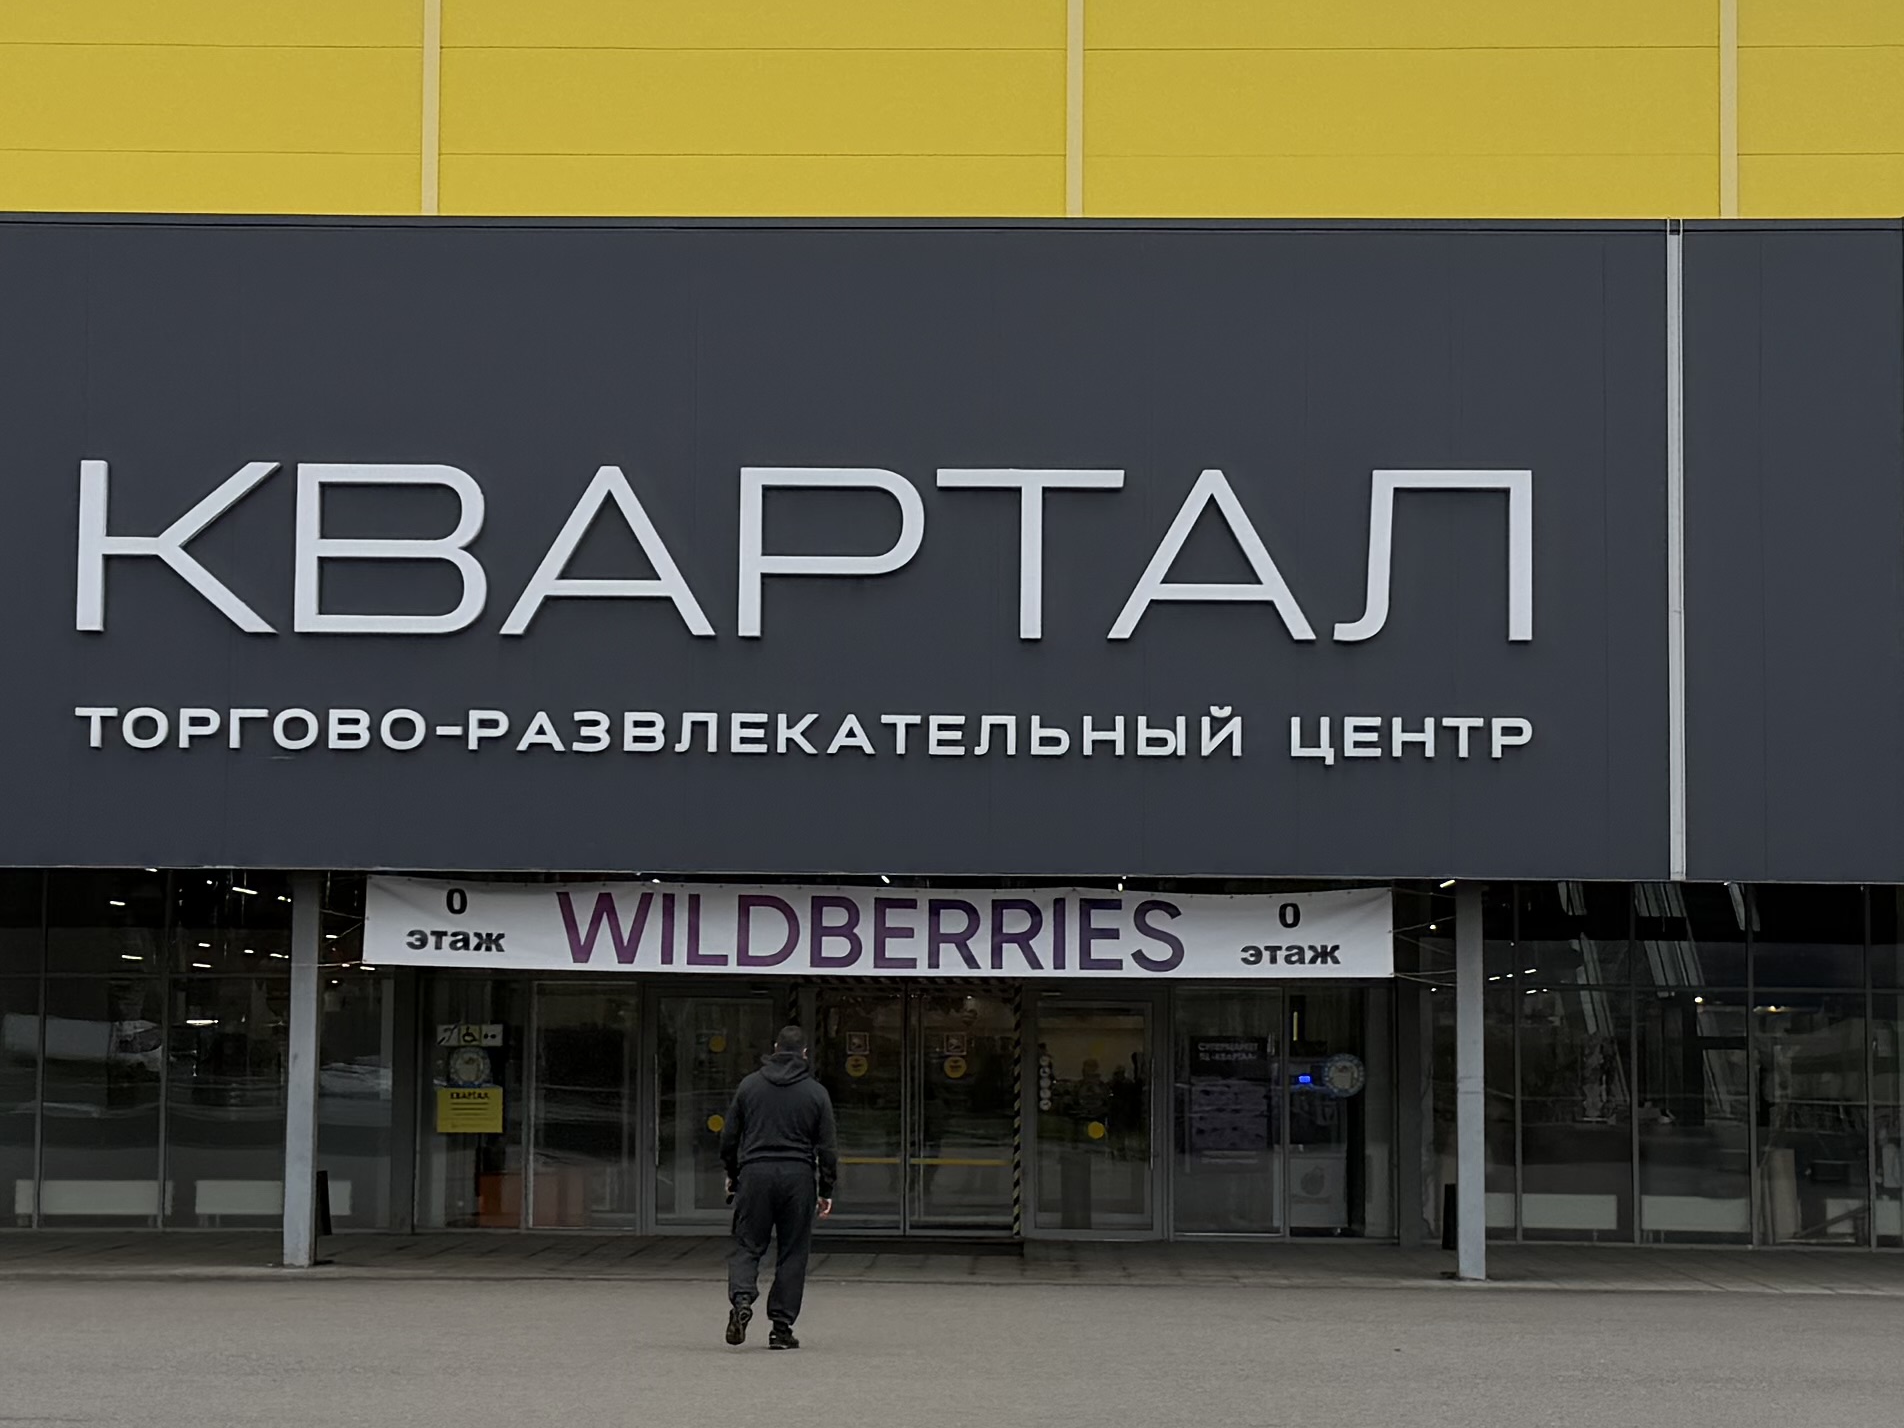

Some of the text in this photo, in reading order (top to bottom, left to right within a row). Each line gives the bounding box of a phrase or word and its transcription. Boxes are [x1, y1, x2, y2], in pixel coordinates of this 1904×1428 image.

[76, 460, 1534, 643] КВАРТАЛ
[75, 706, 1534, 766] ТОРГОВО-РАЗВЛЕКАТЕЛЬНЫЙ ЦЕНТР
[446, 888, 468, 915] 0
[1278, 903, 1301, 928] 0
[406, 929, 505, 952] этаж
[556, 892, 1185, 972] WILDBERRIES
[1241, 942, 1341, 965] этаж
